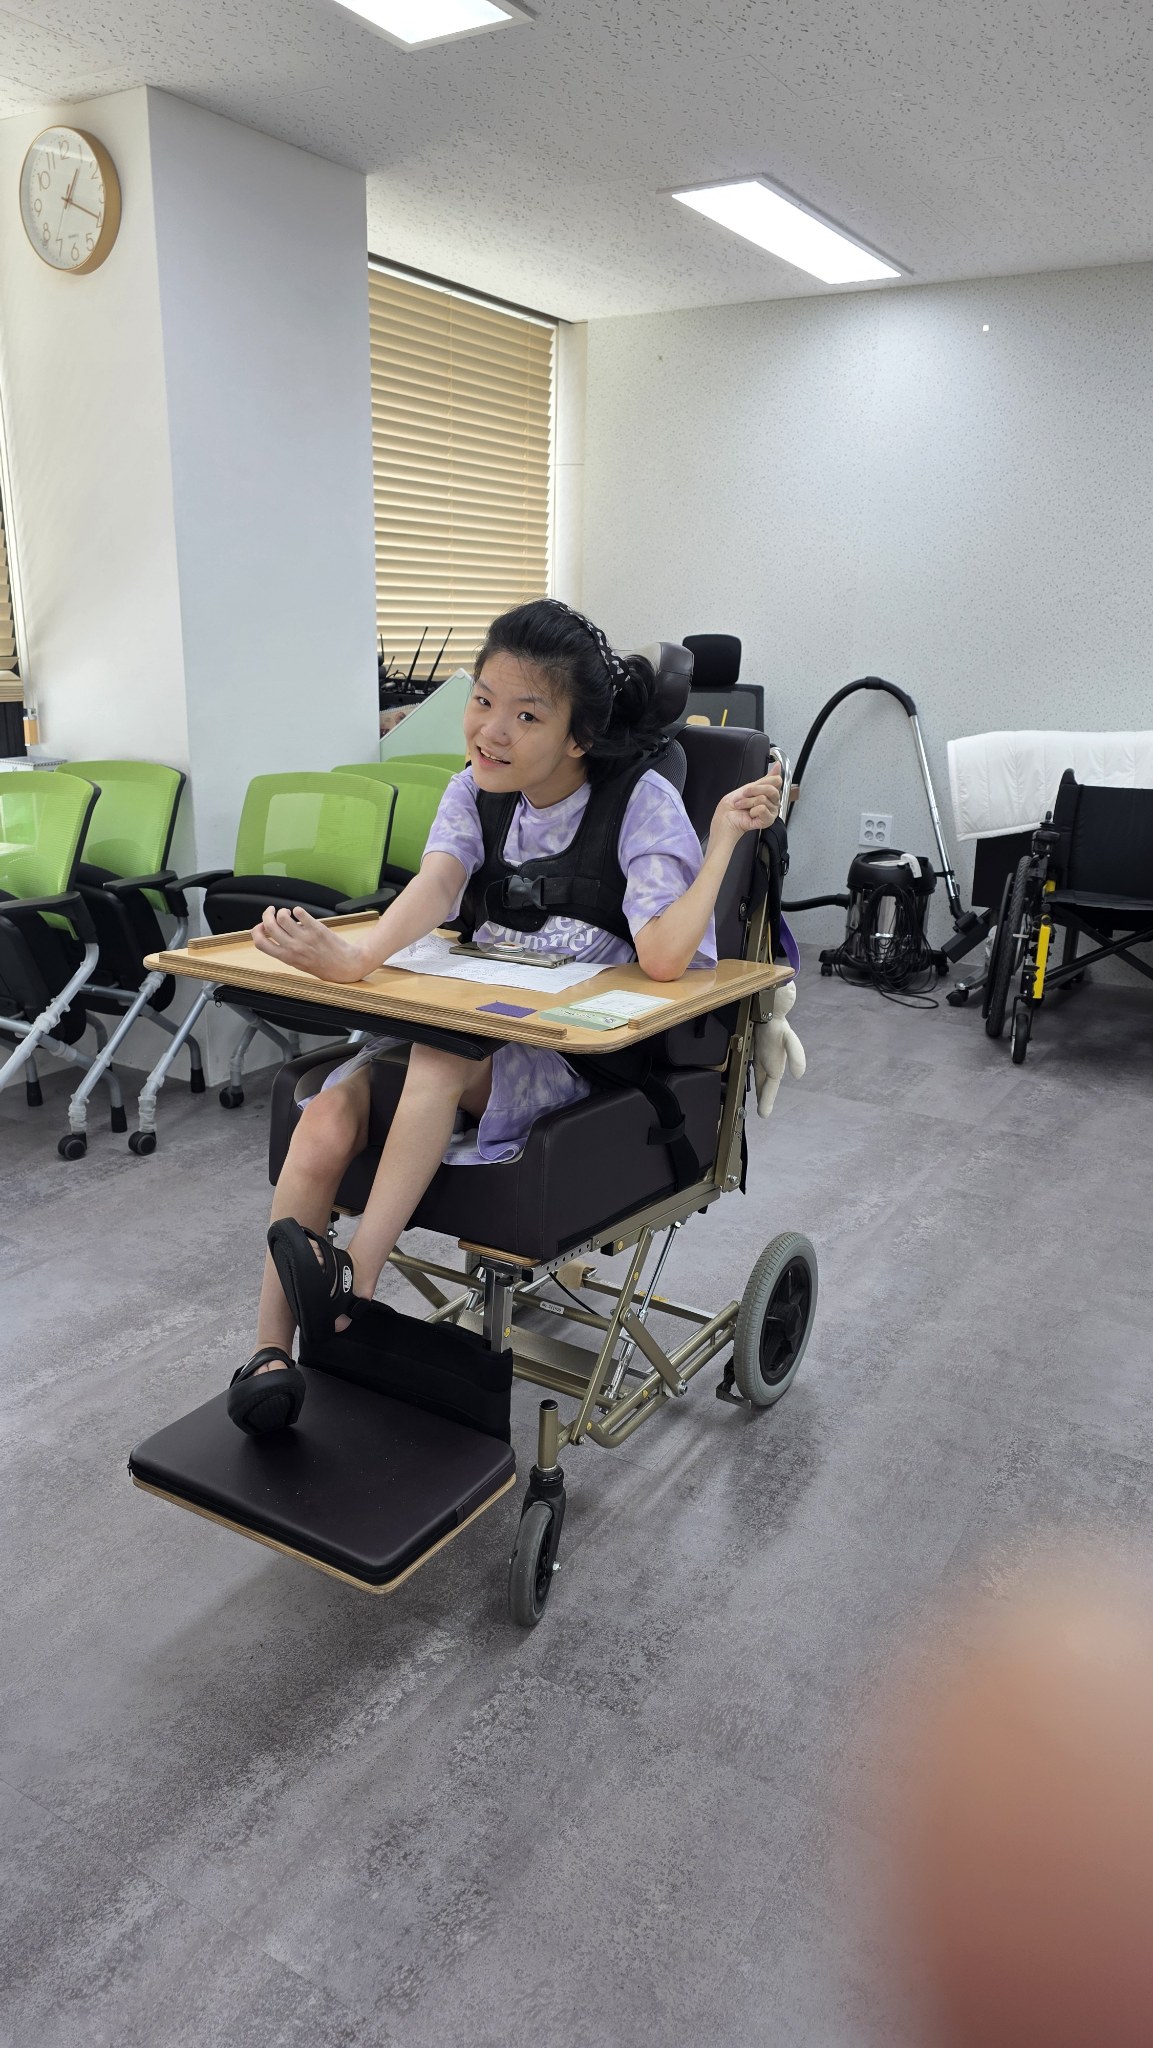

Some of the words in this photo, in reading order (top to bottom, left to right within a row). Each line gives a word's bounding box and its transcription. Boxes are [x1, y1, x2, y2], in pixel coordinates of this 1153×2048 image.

[58, 140, 70, 160] 12
[46, 151, 56, 169] 11
[90, 160, 99, 180] 2
[37, 170, 50, 191] 10
[34, 198, 43, 217] 9
[43, 222, 51, 242] 8
[55, 238, 63, 257] 7
[70, 242, 80, 261] 6
[85, 233, 95, 251] 5
